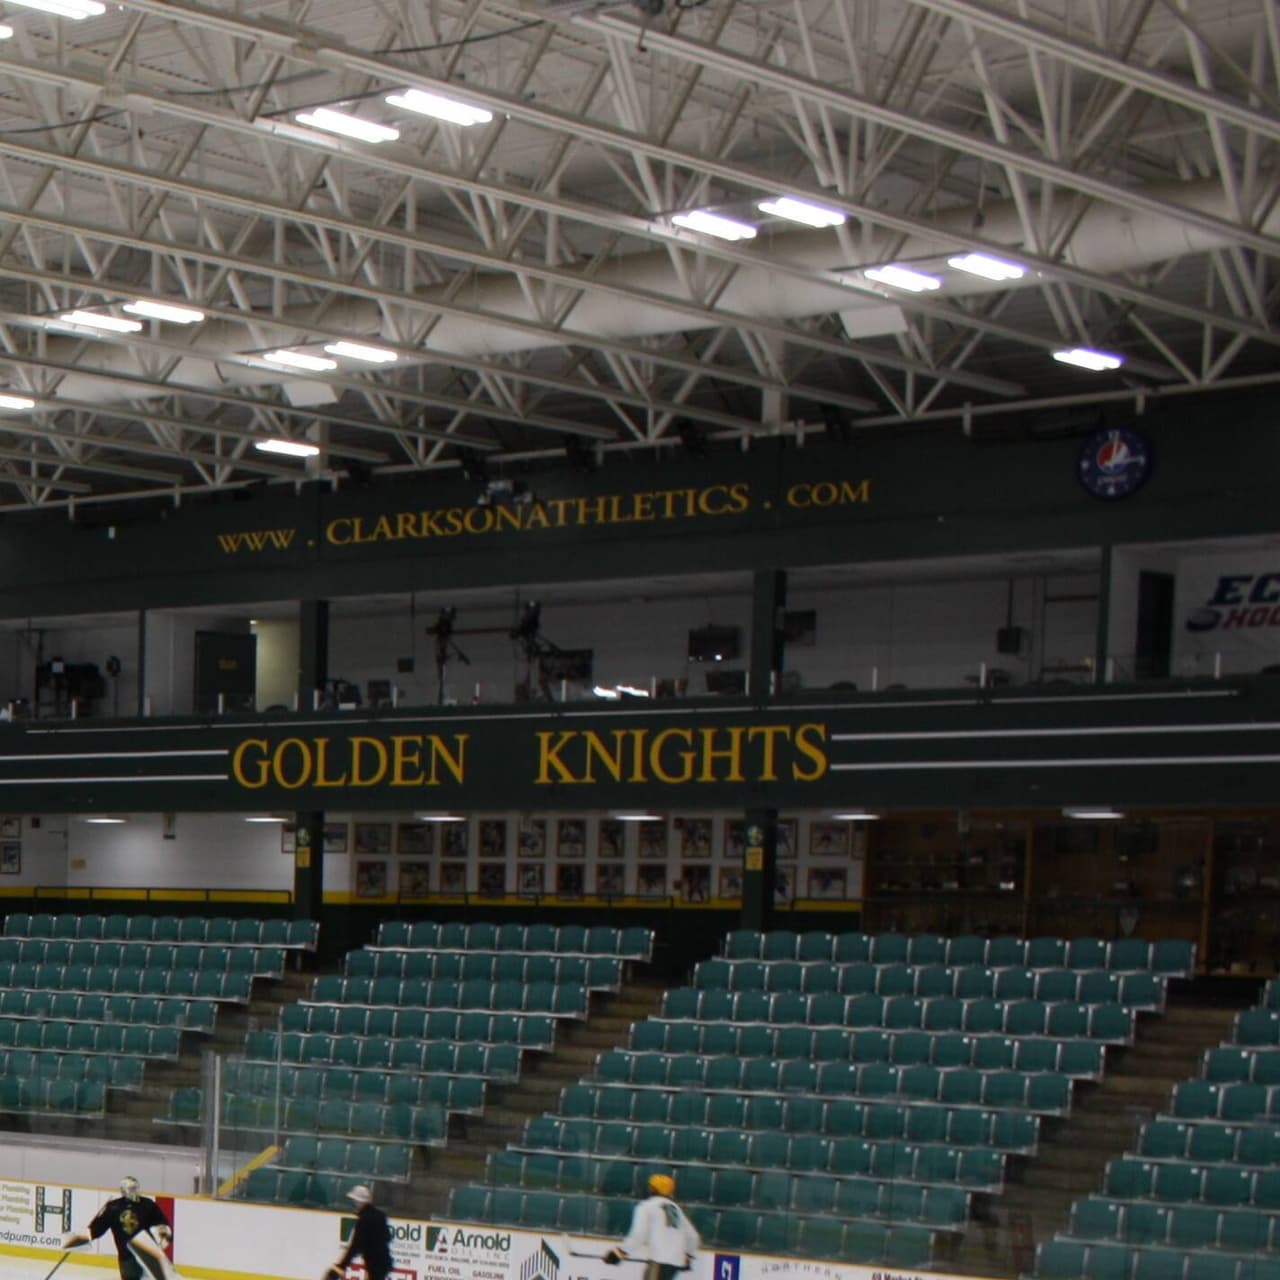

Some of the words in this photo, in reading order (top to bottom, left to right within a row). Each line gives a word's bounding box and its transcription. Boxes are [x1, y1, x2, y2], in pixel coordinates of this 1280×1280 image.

[231, 733, 470, 789] GOLDEN
[533, 722, 829, 784] KNIGHTS
[453, 1228, 511, 1252] Arnold
[427, 1265, 446, 1274] FUEL
[448, 1267, 461, 1276] OIL
